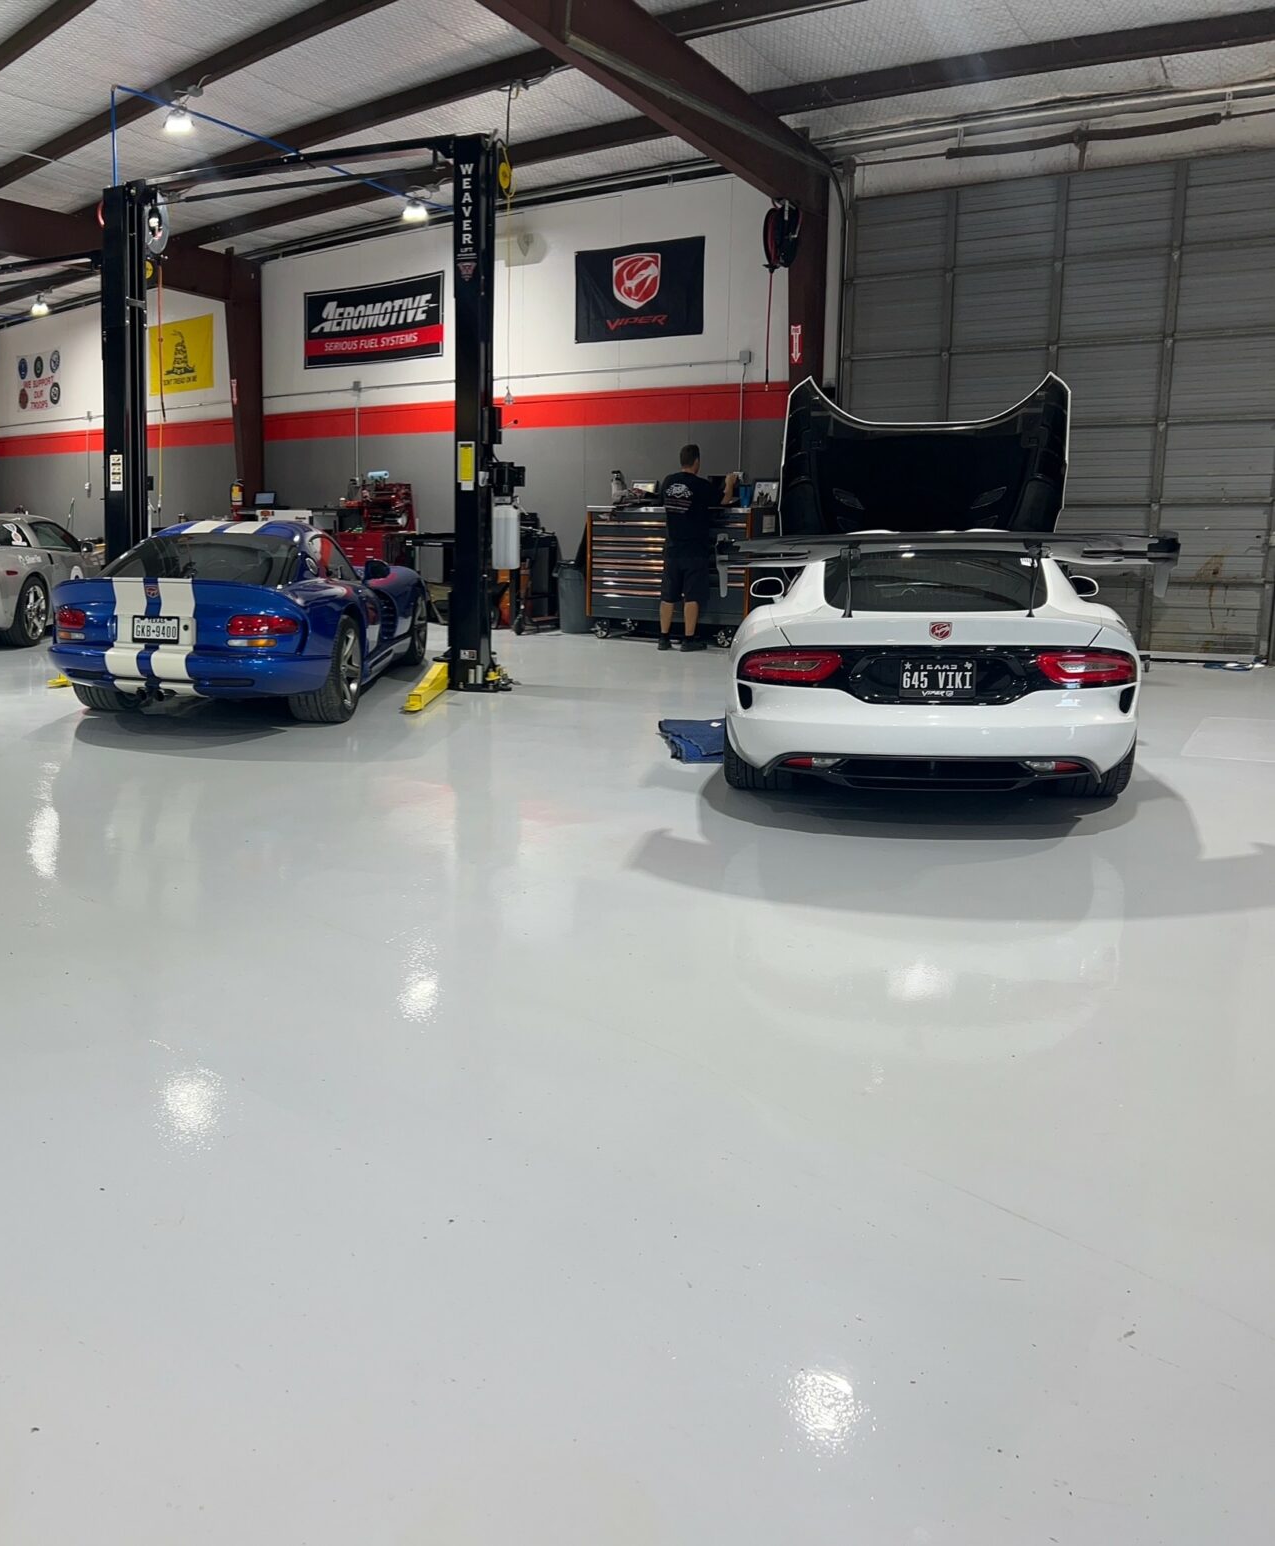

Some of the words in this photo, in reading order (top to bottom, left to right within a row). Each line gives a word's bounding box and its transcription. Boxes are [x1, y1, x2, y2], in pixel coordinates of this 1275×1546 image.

[460, 163, 474, 244] WEAVER
[311, 293, 438, 333] AEROMOTIVE
[606, 314, 668, 331] VIPER
[325, 340, 358, 351] SERIOUS
[359, 337, 378, 349] FUEL
[380, 332, 418, 347] SYSTEMS
[902, 671, 928, 689] 645
[938, 671, 972, 689] VIKI
